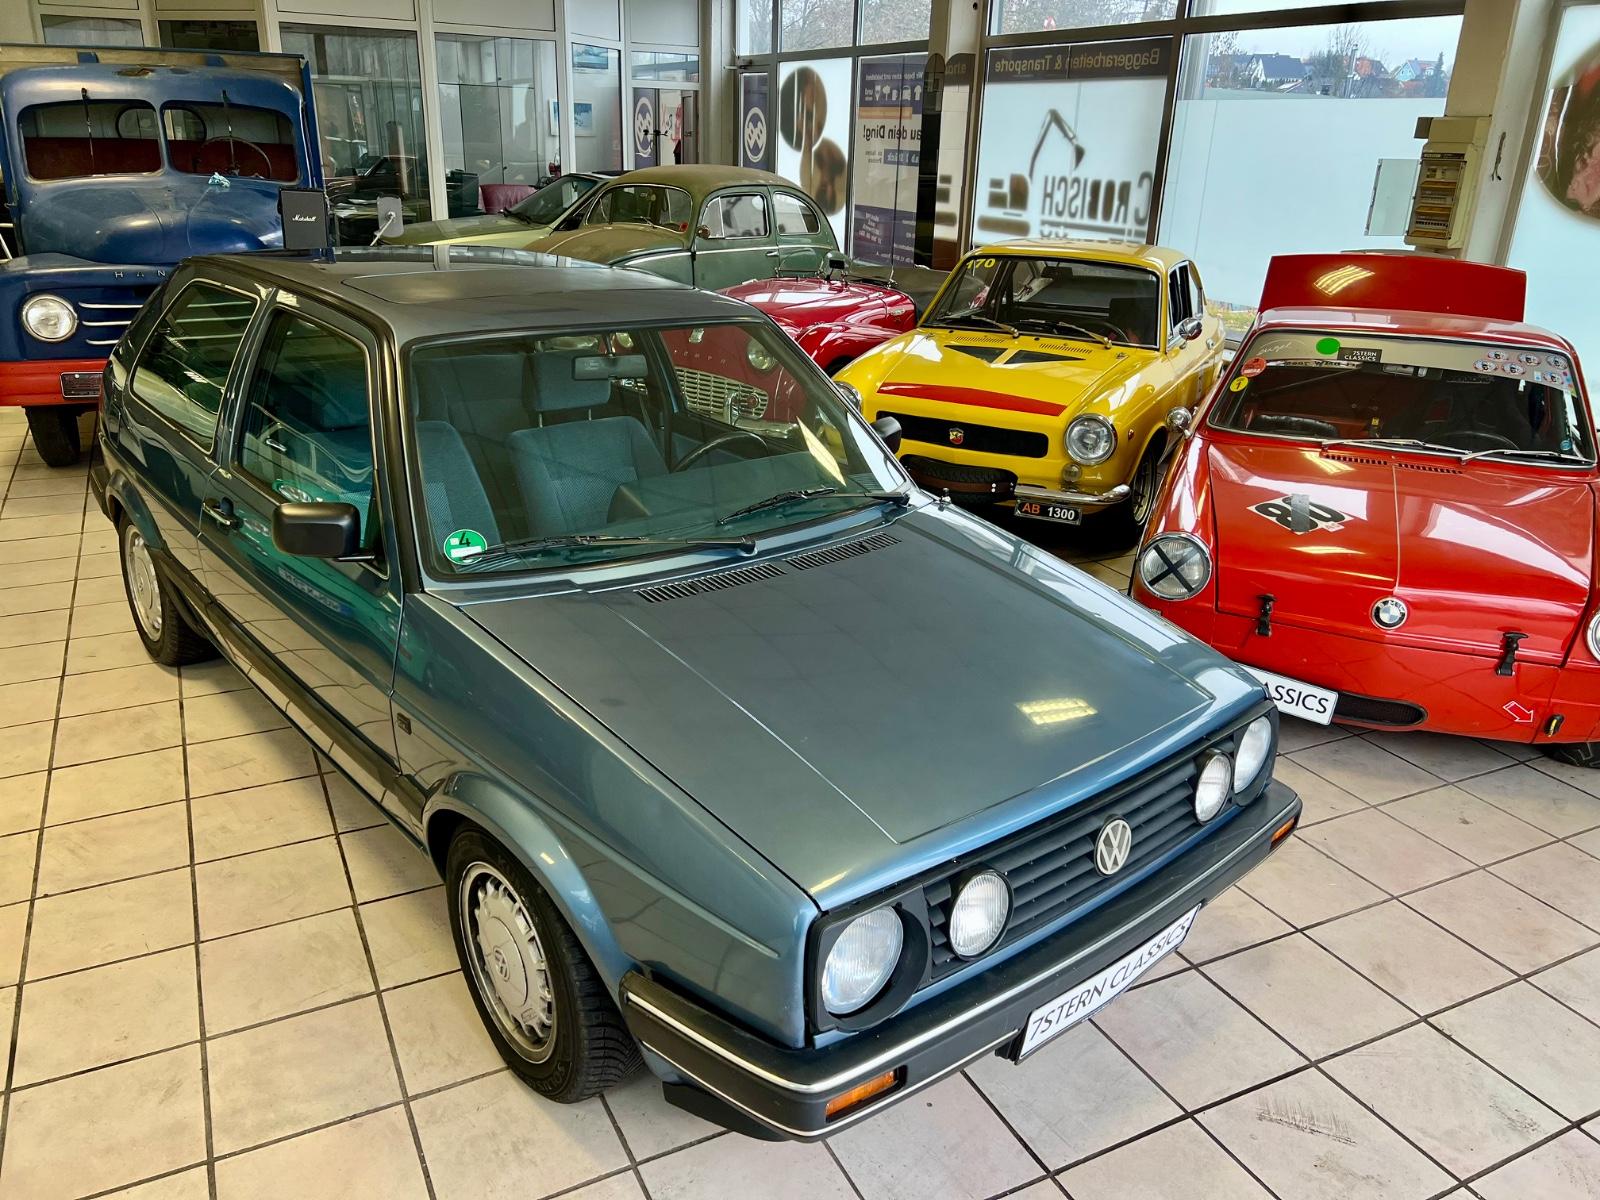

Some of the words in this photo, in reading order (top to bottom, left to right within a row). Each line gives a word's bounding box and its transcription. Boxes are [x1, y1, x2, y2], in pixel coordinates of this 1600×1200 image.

[966, 258, 996, 269] 170
[1022, 502, 1040, 514] AB
[1047, 506, 1075, 520] 1300
[459, 531, 471, 547] 4
[1030, 977, 1107, 1041] 7STERN
[1109, 917, 1191, 990] CLASSICS
